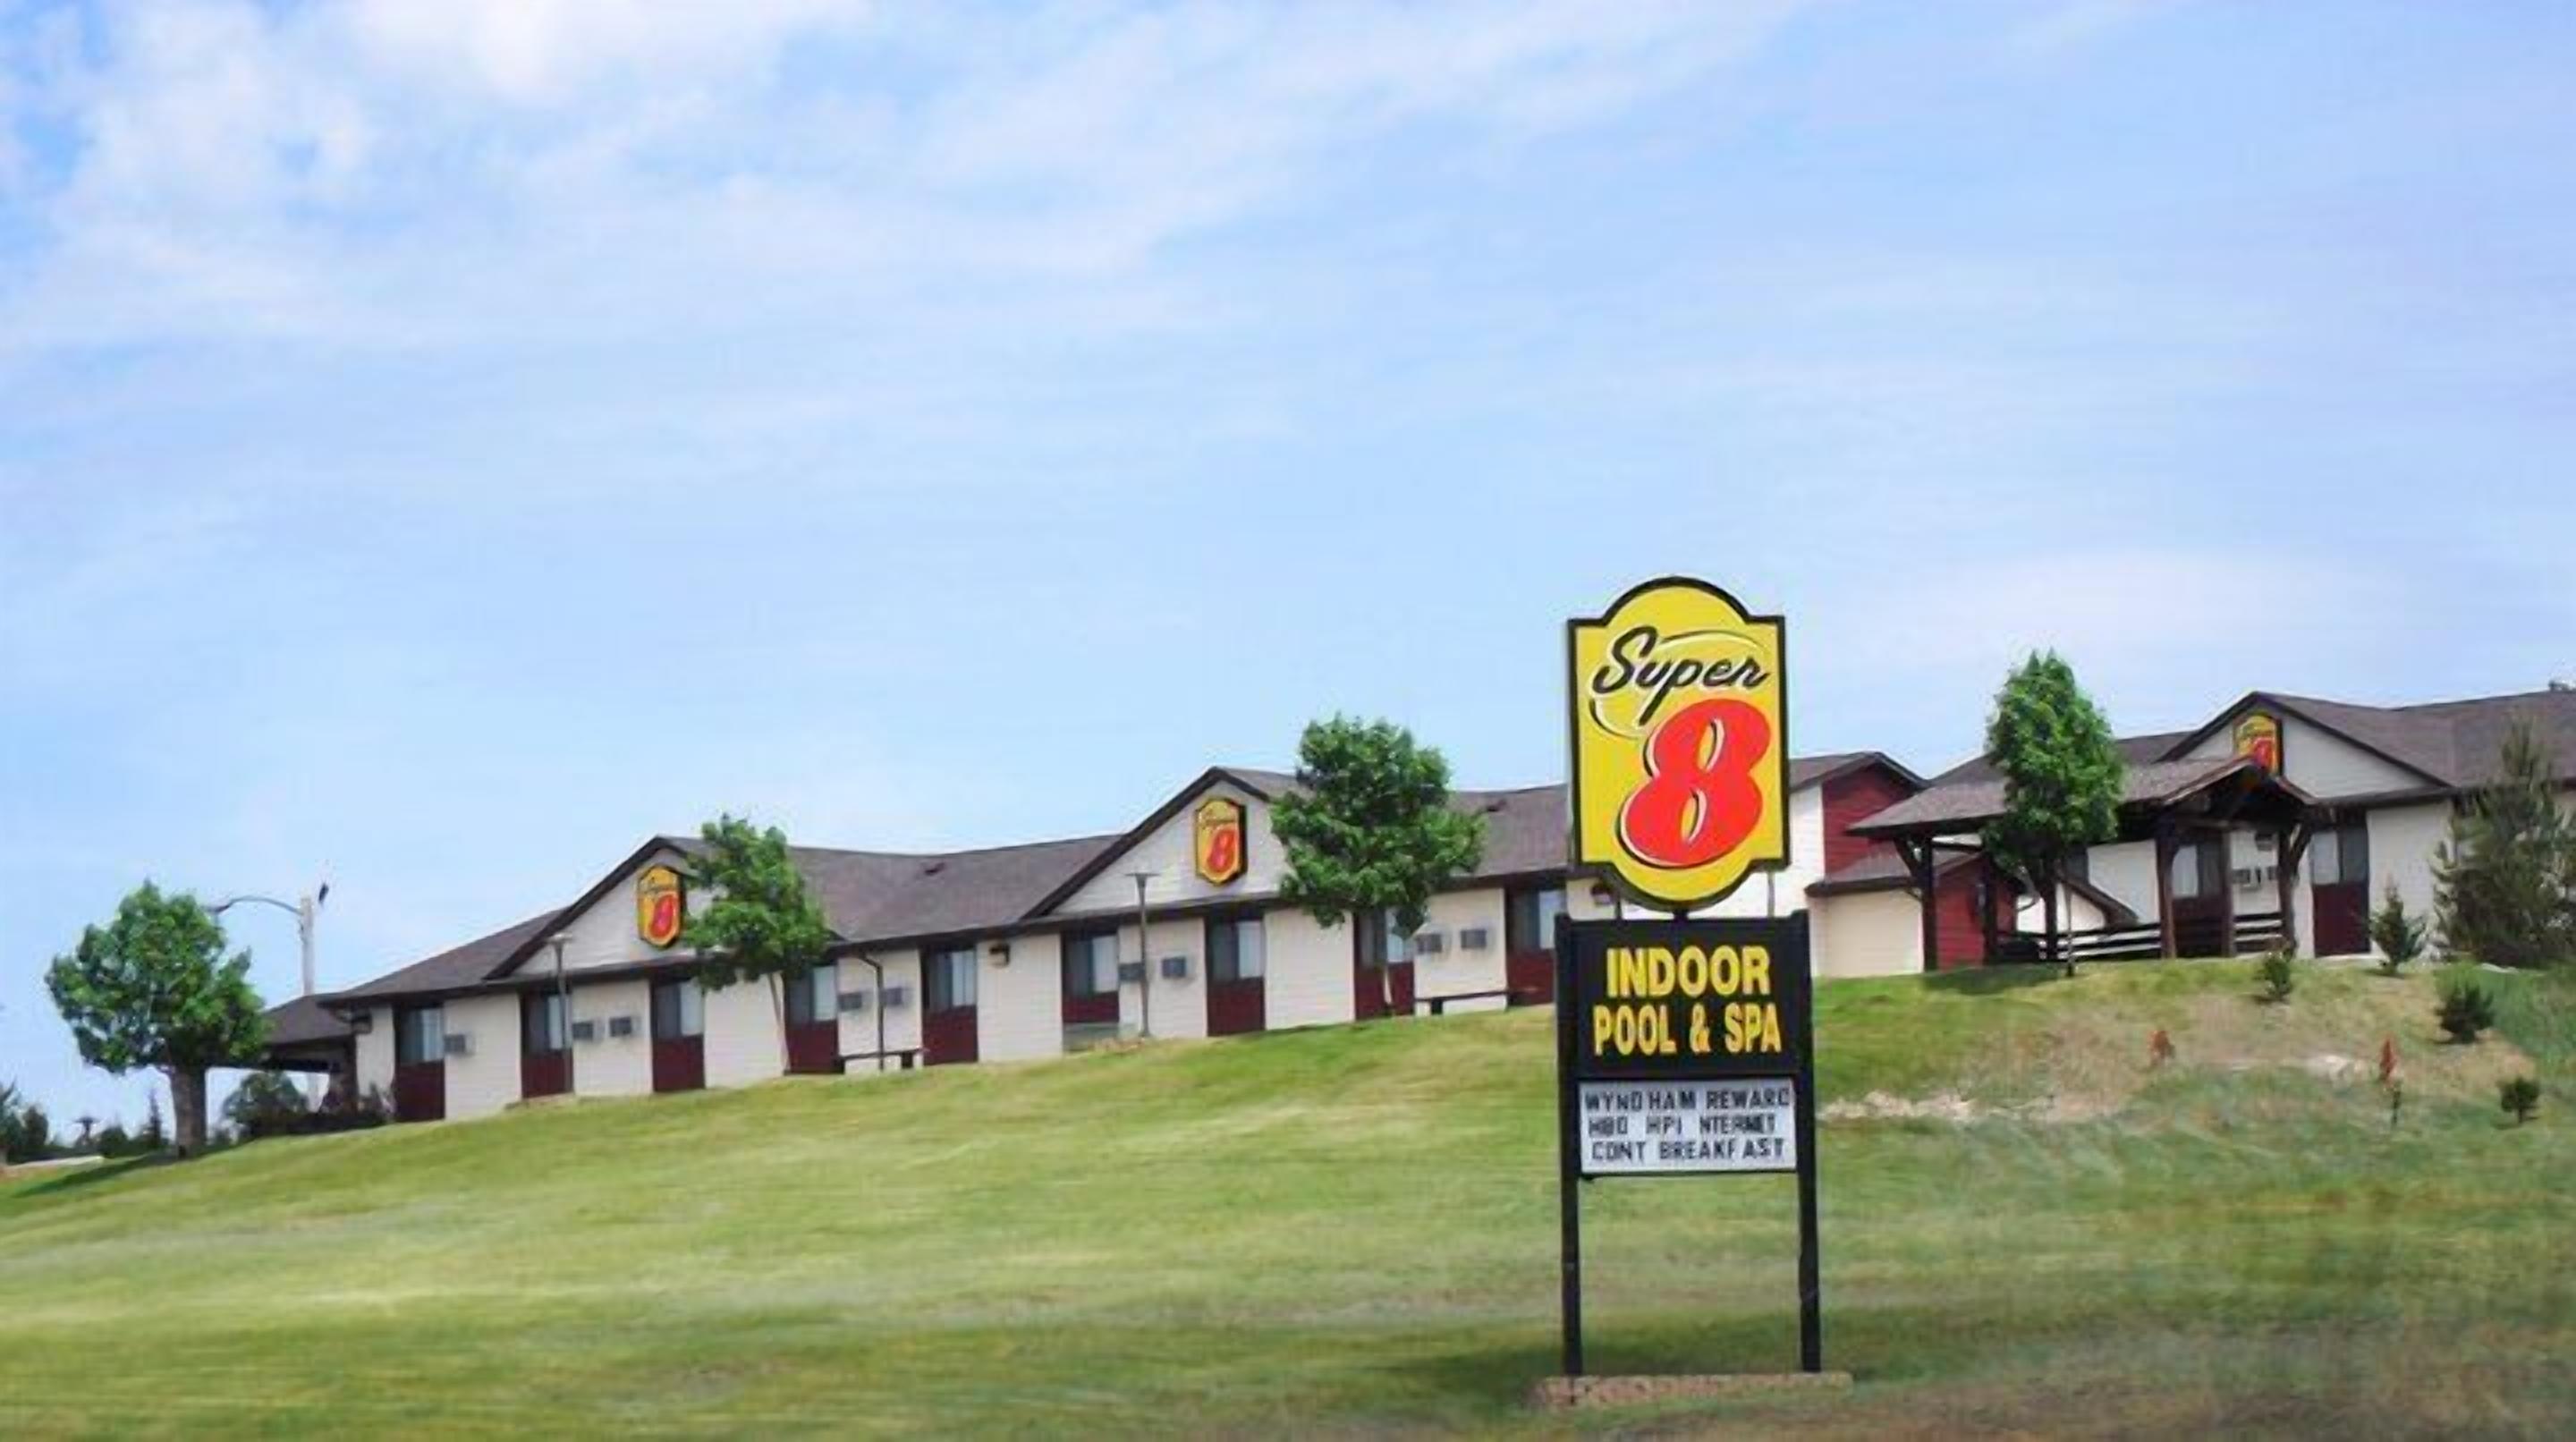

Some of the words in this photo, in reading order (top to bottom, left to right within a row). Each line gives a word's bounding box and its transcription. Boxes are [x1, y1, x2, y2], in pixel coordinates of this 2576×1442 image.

[1591, 625, 1771, 726] Super
[1617, 699, 1771, 869] 8
[1606, 945, 1771, 998] INDOOR
[1592, 1003, 1678, 1056] POOL
[1688, 1002, 1712, 1054] &
[1724, 1001, 1783, 1054] SPA
[1592, 1141, 1646, 1162] CONT
[1660, 1137, 1784, 1160] BREAKFAST
